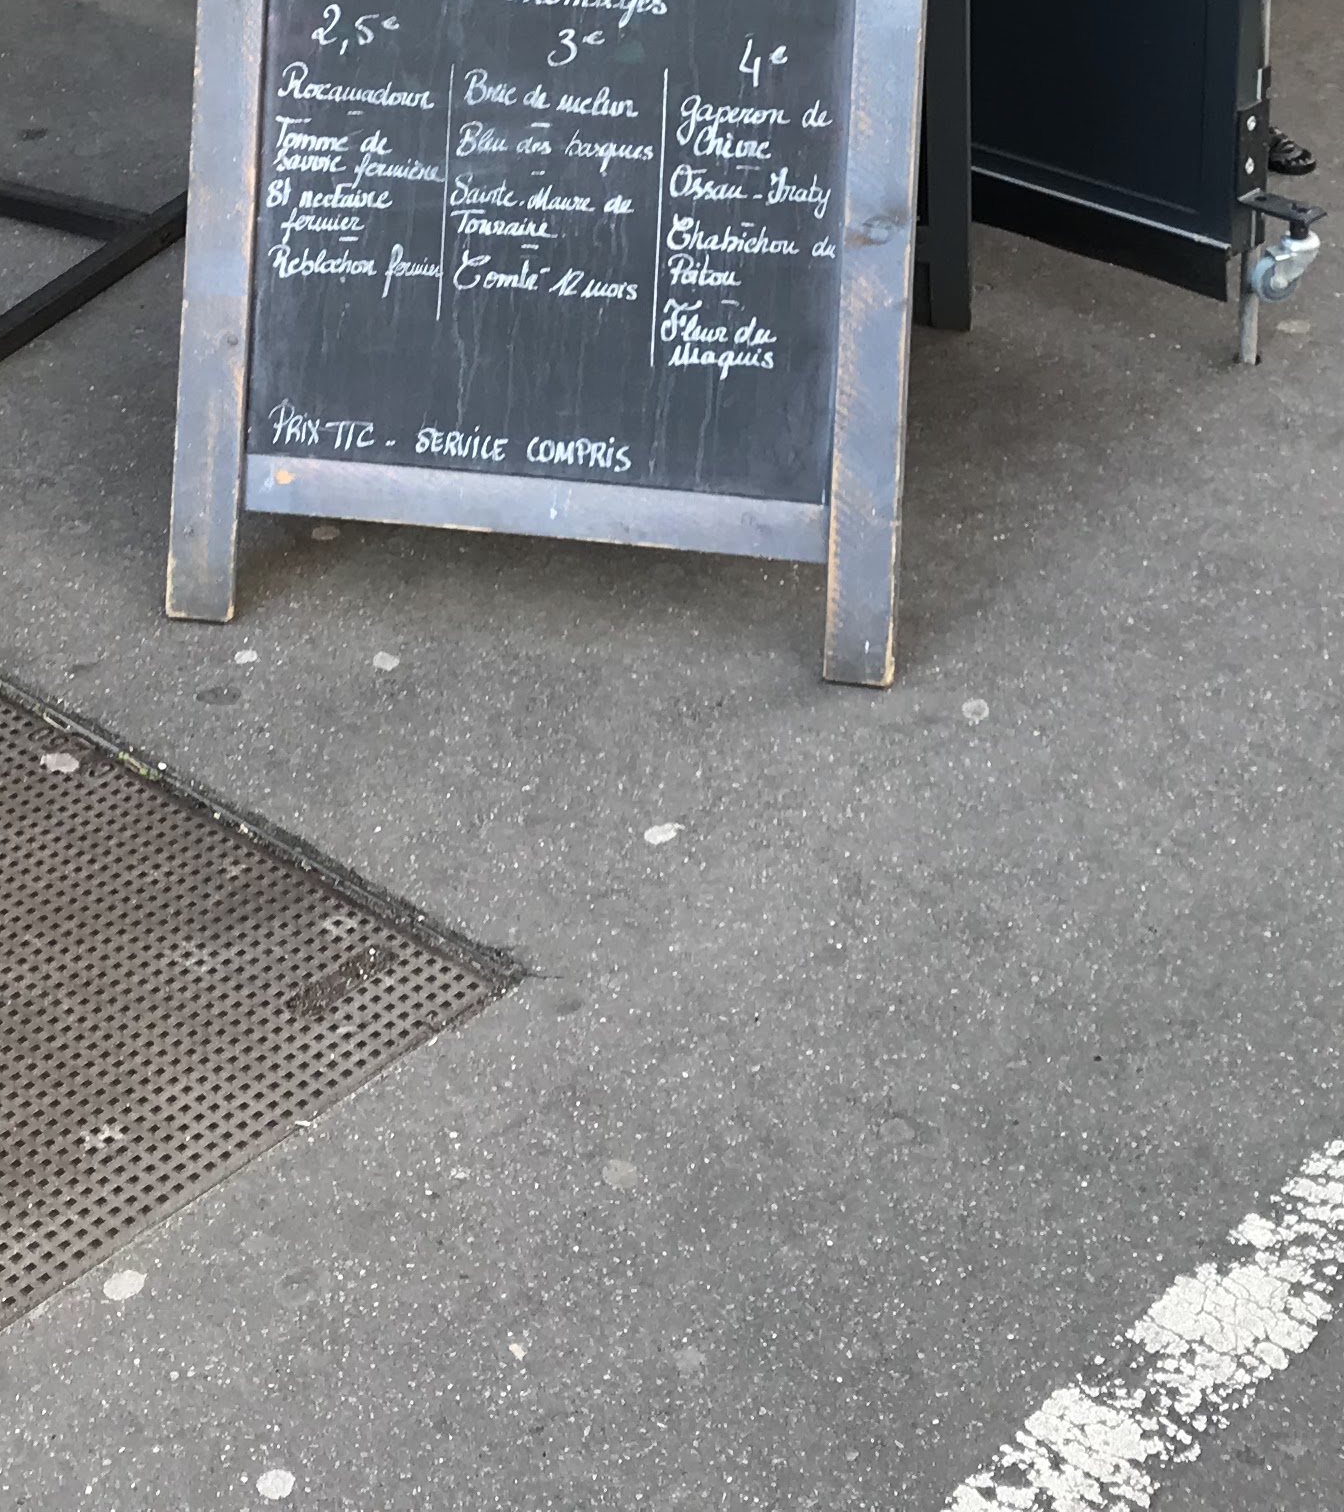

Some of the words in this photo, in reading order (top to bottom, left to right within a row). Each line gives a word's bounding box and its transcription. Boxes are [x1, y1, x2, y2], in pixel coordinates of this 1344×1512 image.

[277, 61, 435, 109] Rocamadour
[464, 68, 517, 105] Brie
[523, 84, 551, 109] de
[802, 99, 833, 128] de
[275, 115, 350, 151] Tomme
[360, 130, 393, 155] de
[456, 121, 508, 157] Bleu
[565, 130, 654, 174] basques
[281, 207, 365, 245] fermier
[451, 209, 558, 238] Touraine
[667, 213, 799, 254] Chabichou
[268, 245, 377, 278] Reblochon
[453, 250, 551, 290] Comté
[661, 299, 728, 342] Fleur
[734, 317, 777, 345] du
[415, 426, 509, 462] SERVICE
